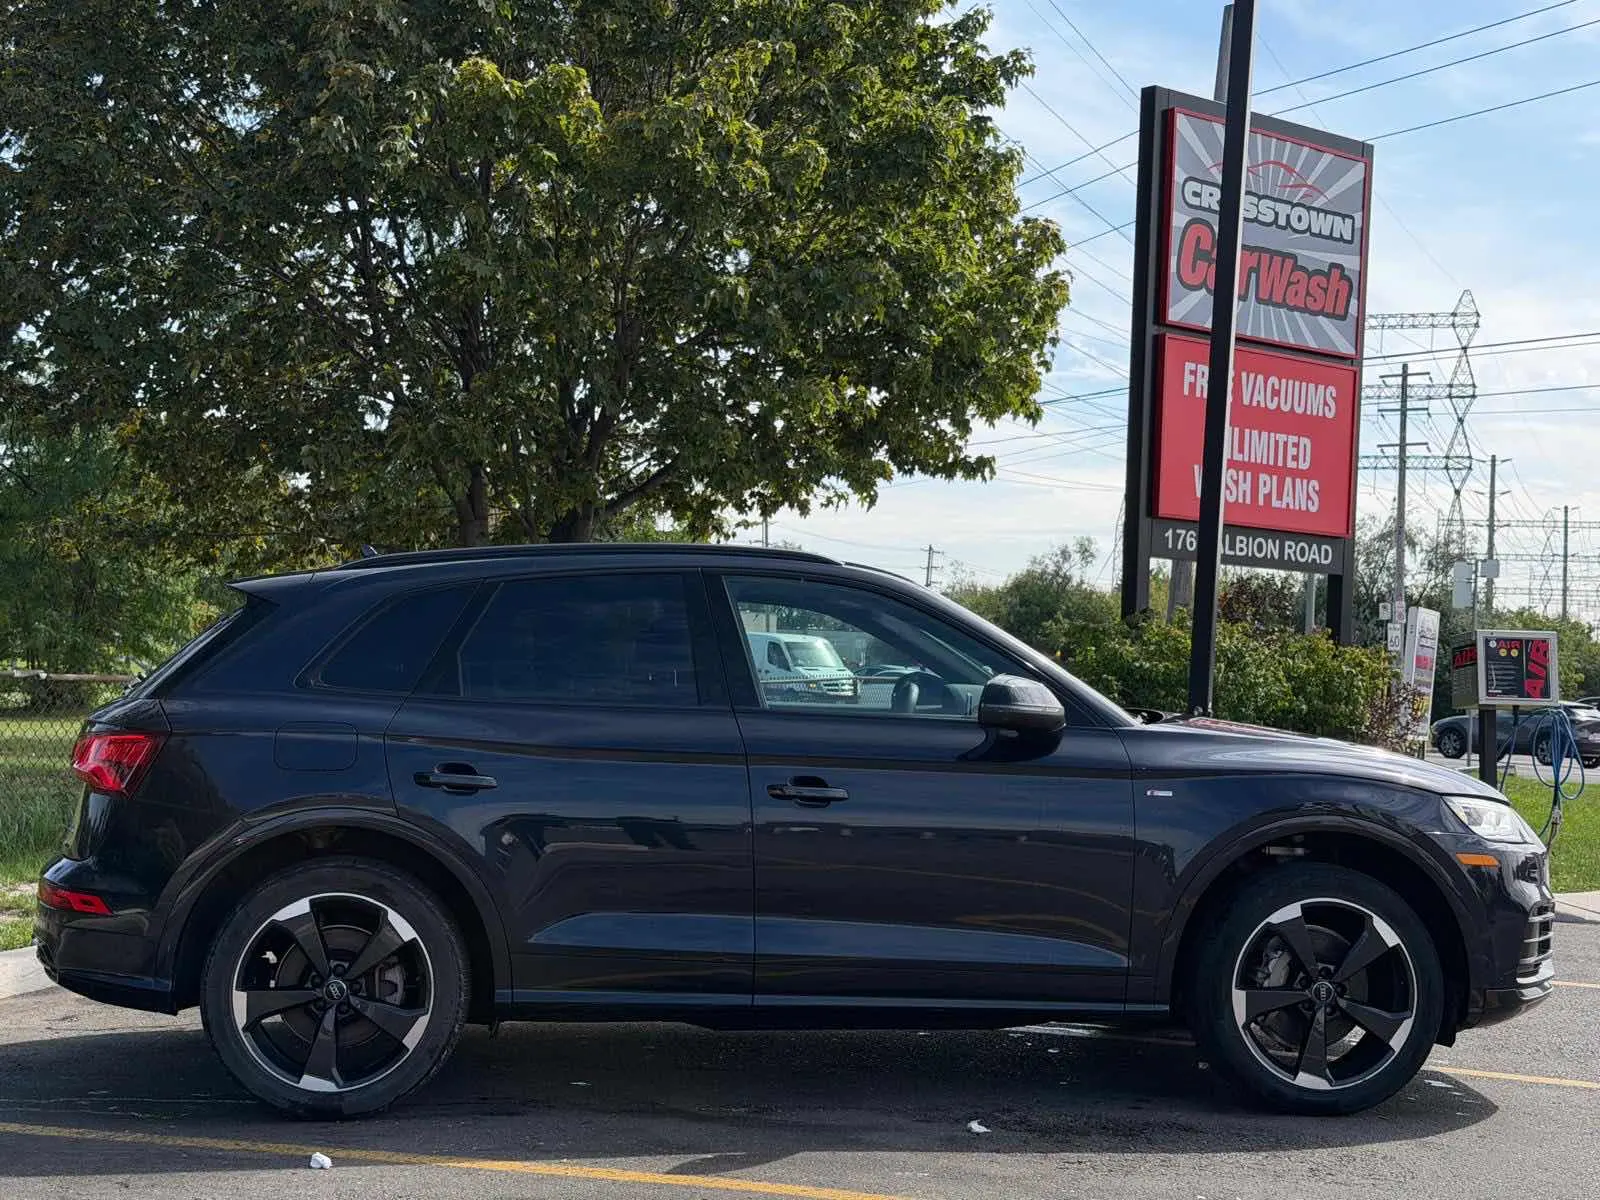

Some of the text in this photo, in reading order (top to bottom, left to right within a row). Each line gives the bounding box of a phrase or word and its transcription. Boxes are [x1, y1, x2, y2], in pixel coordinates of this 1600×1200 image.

[1182, 178, 1354, 243] CRSSTOWN
[1241, 371, 1336, 418] VACUUMS
[1258, 472, 1319, 512] PLANS
[1284, 541, 1333, 564] ROAD
[1497, 640, 1521, 649] AIR
